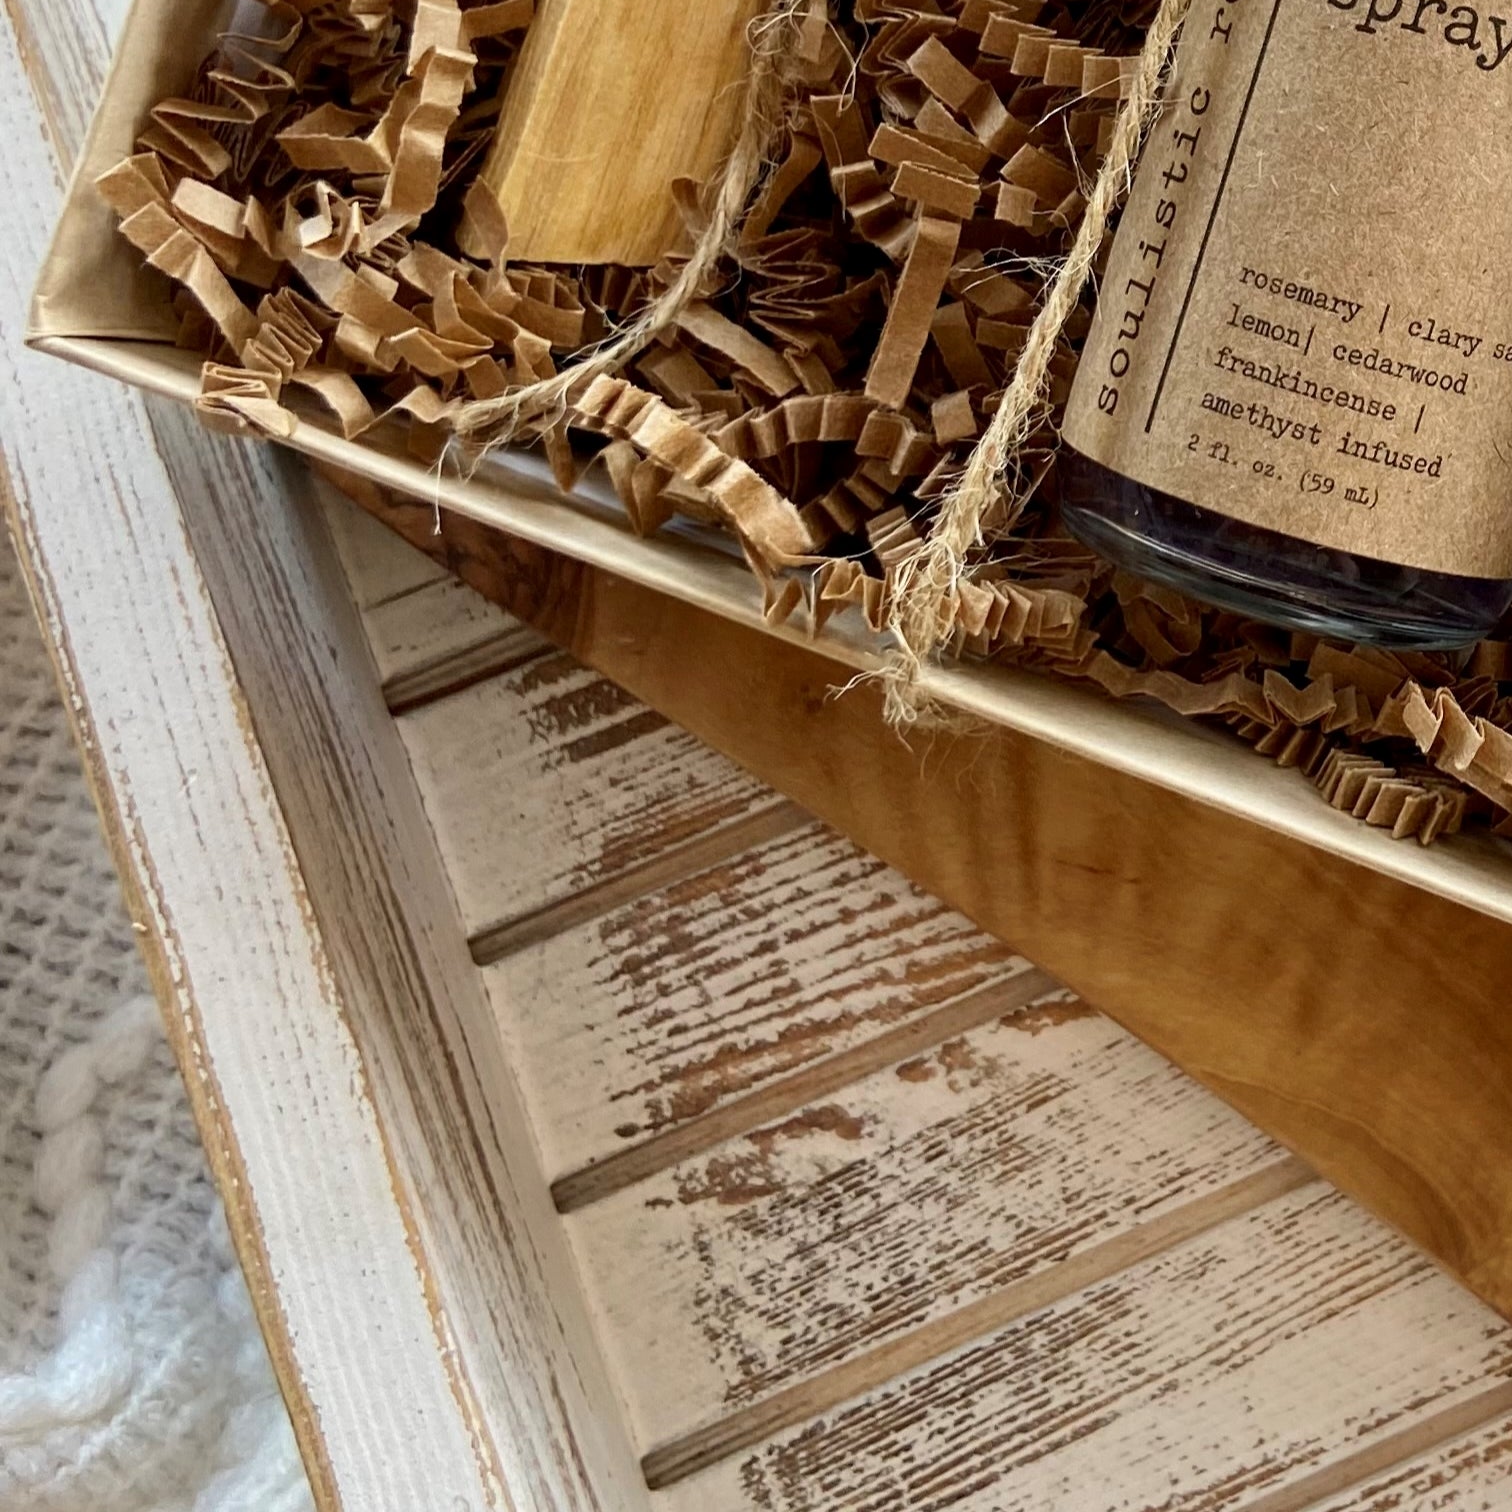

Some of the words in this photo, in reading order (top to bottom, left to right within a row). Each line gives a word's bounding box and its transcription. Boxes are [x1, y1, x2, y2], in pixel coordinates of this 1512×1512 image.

[1097, 86, 1211, 417] soulistic
[1238, 265, 1365, 324] rosemary
[1407, 317, 1483, 358] clary
[1213, 346, 1397, 421] frankincense
[1332, 343, 1469, 396] cedarwood
[1187, 433, 1200, 452] 2
[1208, 440, 1238, 466] fl.
[1252, 460, 1283, 481] oz.
[1299, 468, 1336, 494] (59
[1343, 485, 1380, 510] mL)
[1200, 391, 1323, 446] amethyst
[1336, 431, 1443, 478] infused
